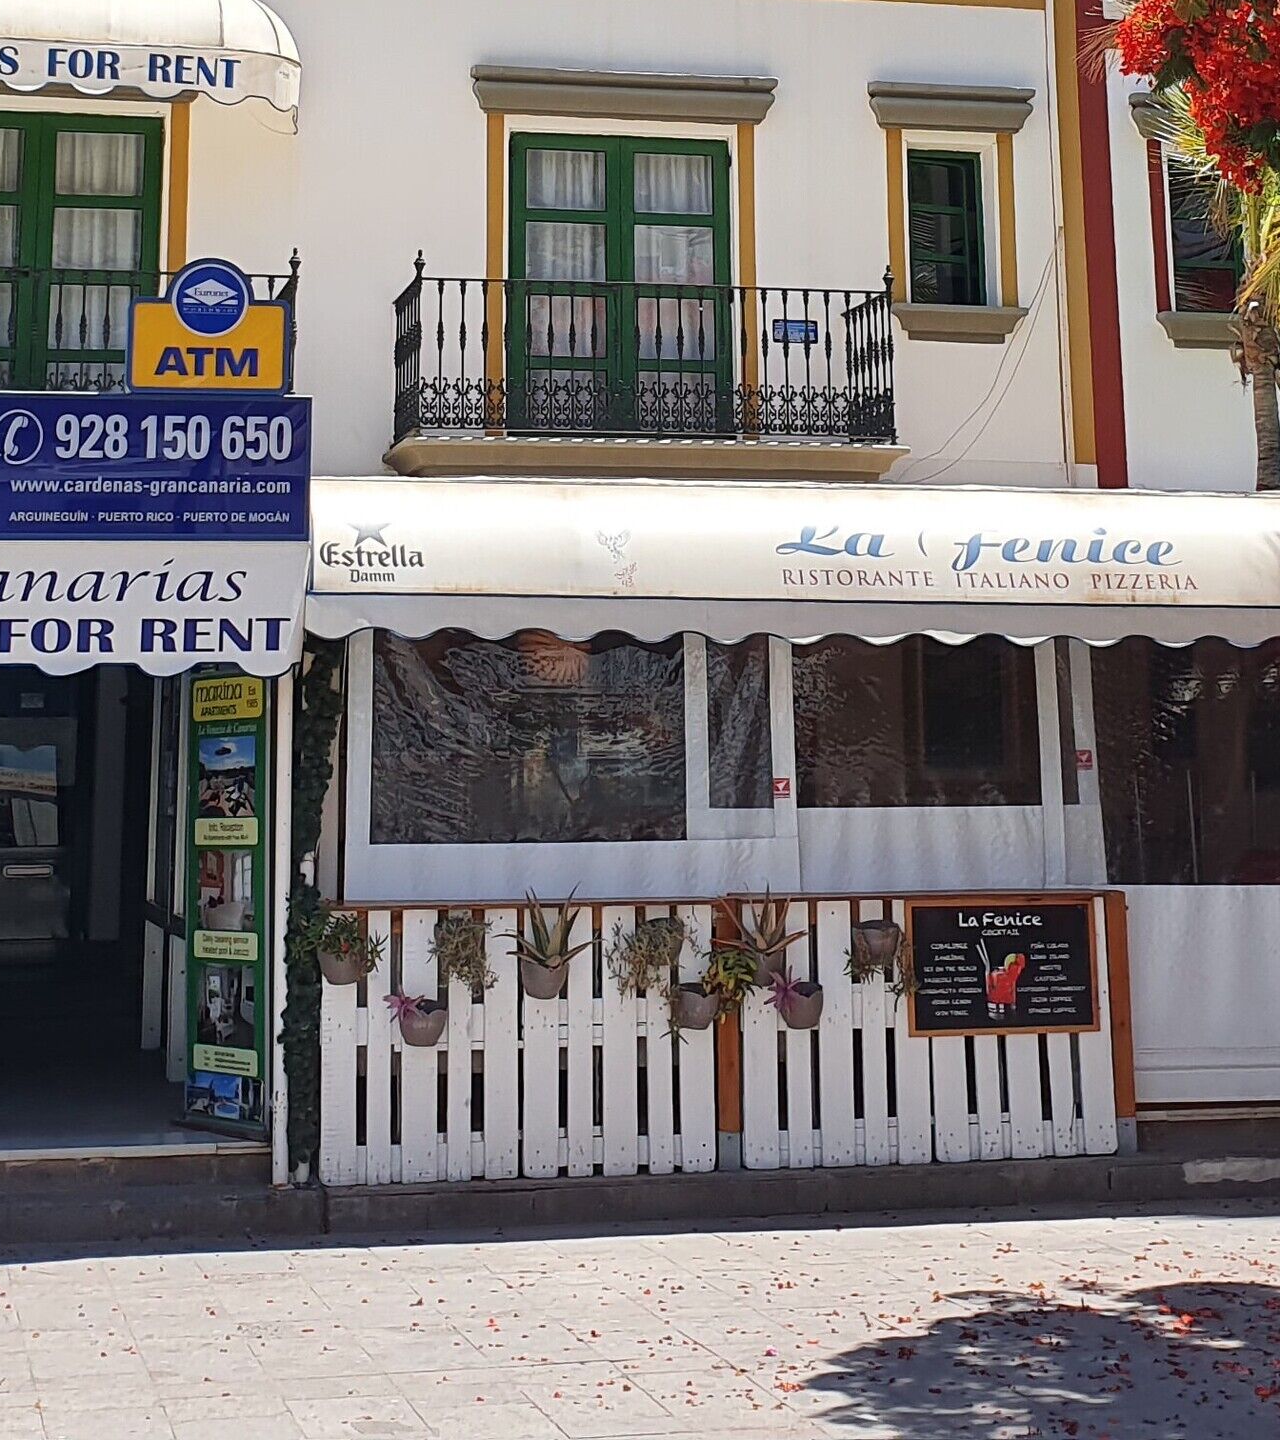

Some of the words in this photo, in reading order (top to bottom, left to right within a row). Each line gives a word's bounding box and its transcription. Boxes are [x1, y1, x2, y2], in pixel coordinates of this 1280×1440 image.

[48, 48, 120, 80] FOR
[149, 53, 241, 88] RENT
[154, 347, 259, 377] ATM
[55, 414, 127, 459] 928
[141, 416, 210, 459] 150
[221, 416, 292, 460] 650
[10, 476, 291, 496] www.cardenas-grancanaria.com
[9, 511, 89, 523] ARGUINEGUÍN
[98, 512, 144, 523] PUERTO
[146, 512, 174, 523] RICO
[183, 512, 229, 523] PUERTO
[231, 513, 246, 523] DE
[248, 511, 290, 524] MOGÁN
[775, 524, 895, 557] La
[320, 541, 425, 568] Estrella
[349, 569, 396, 583] Damm
[781, 568, 934, 588] RISTORANTE
[956, 571, 1070, 590] ITALIANO
[1091, 574, 1199, 591] PIZZERIA
[140, 617, 291, 653] RENT
[958, 912, 979, 927] La
[982, 912, 1043, 927] Fenice
